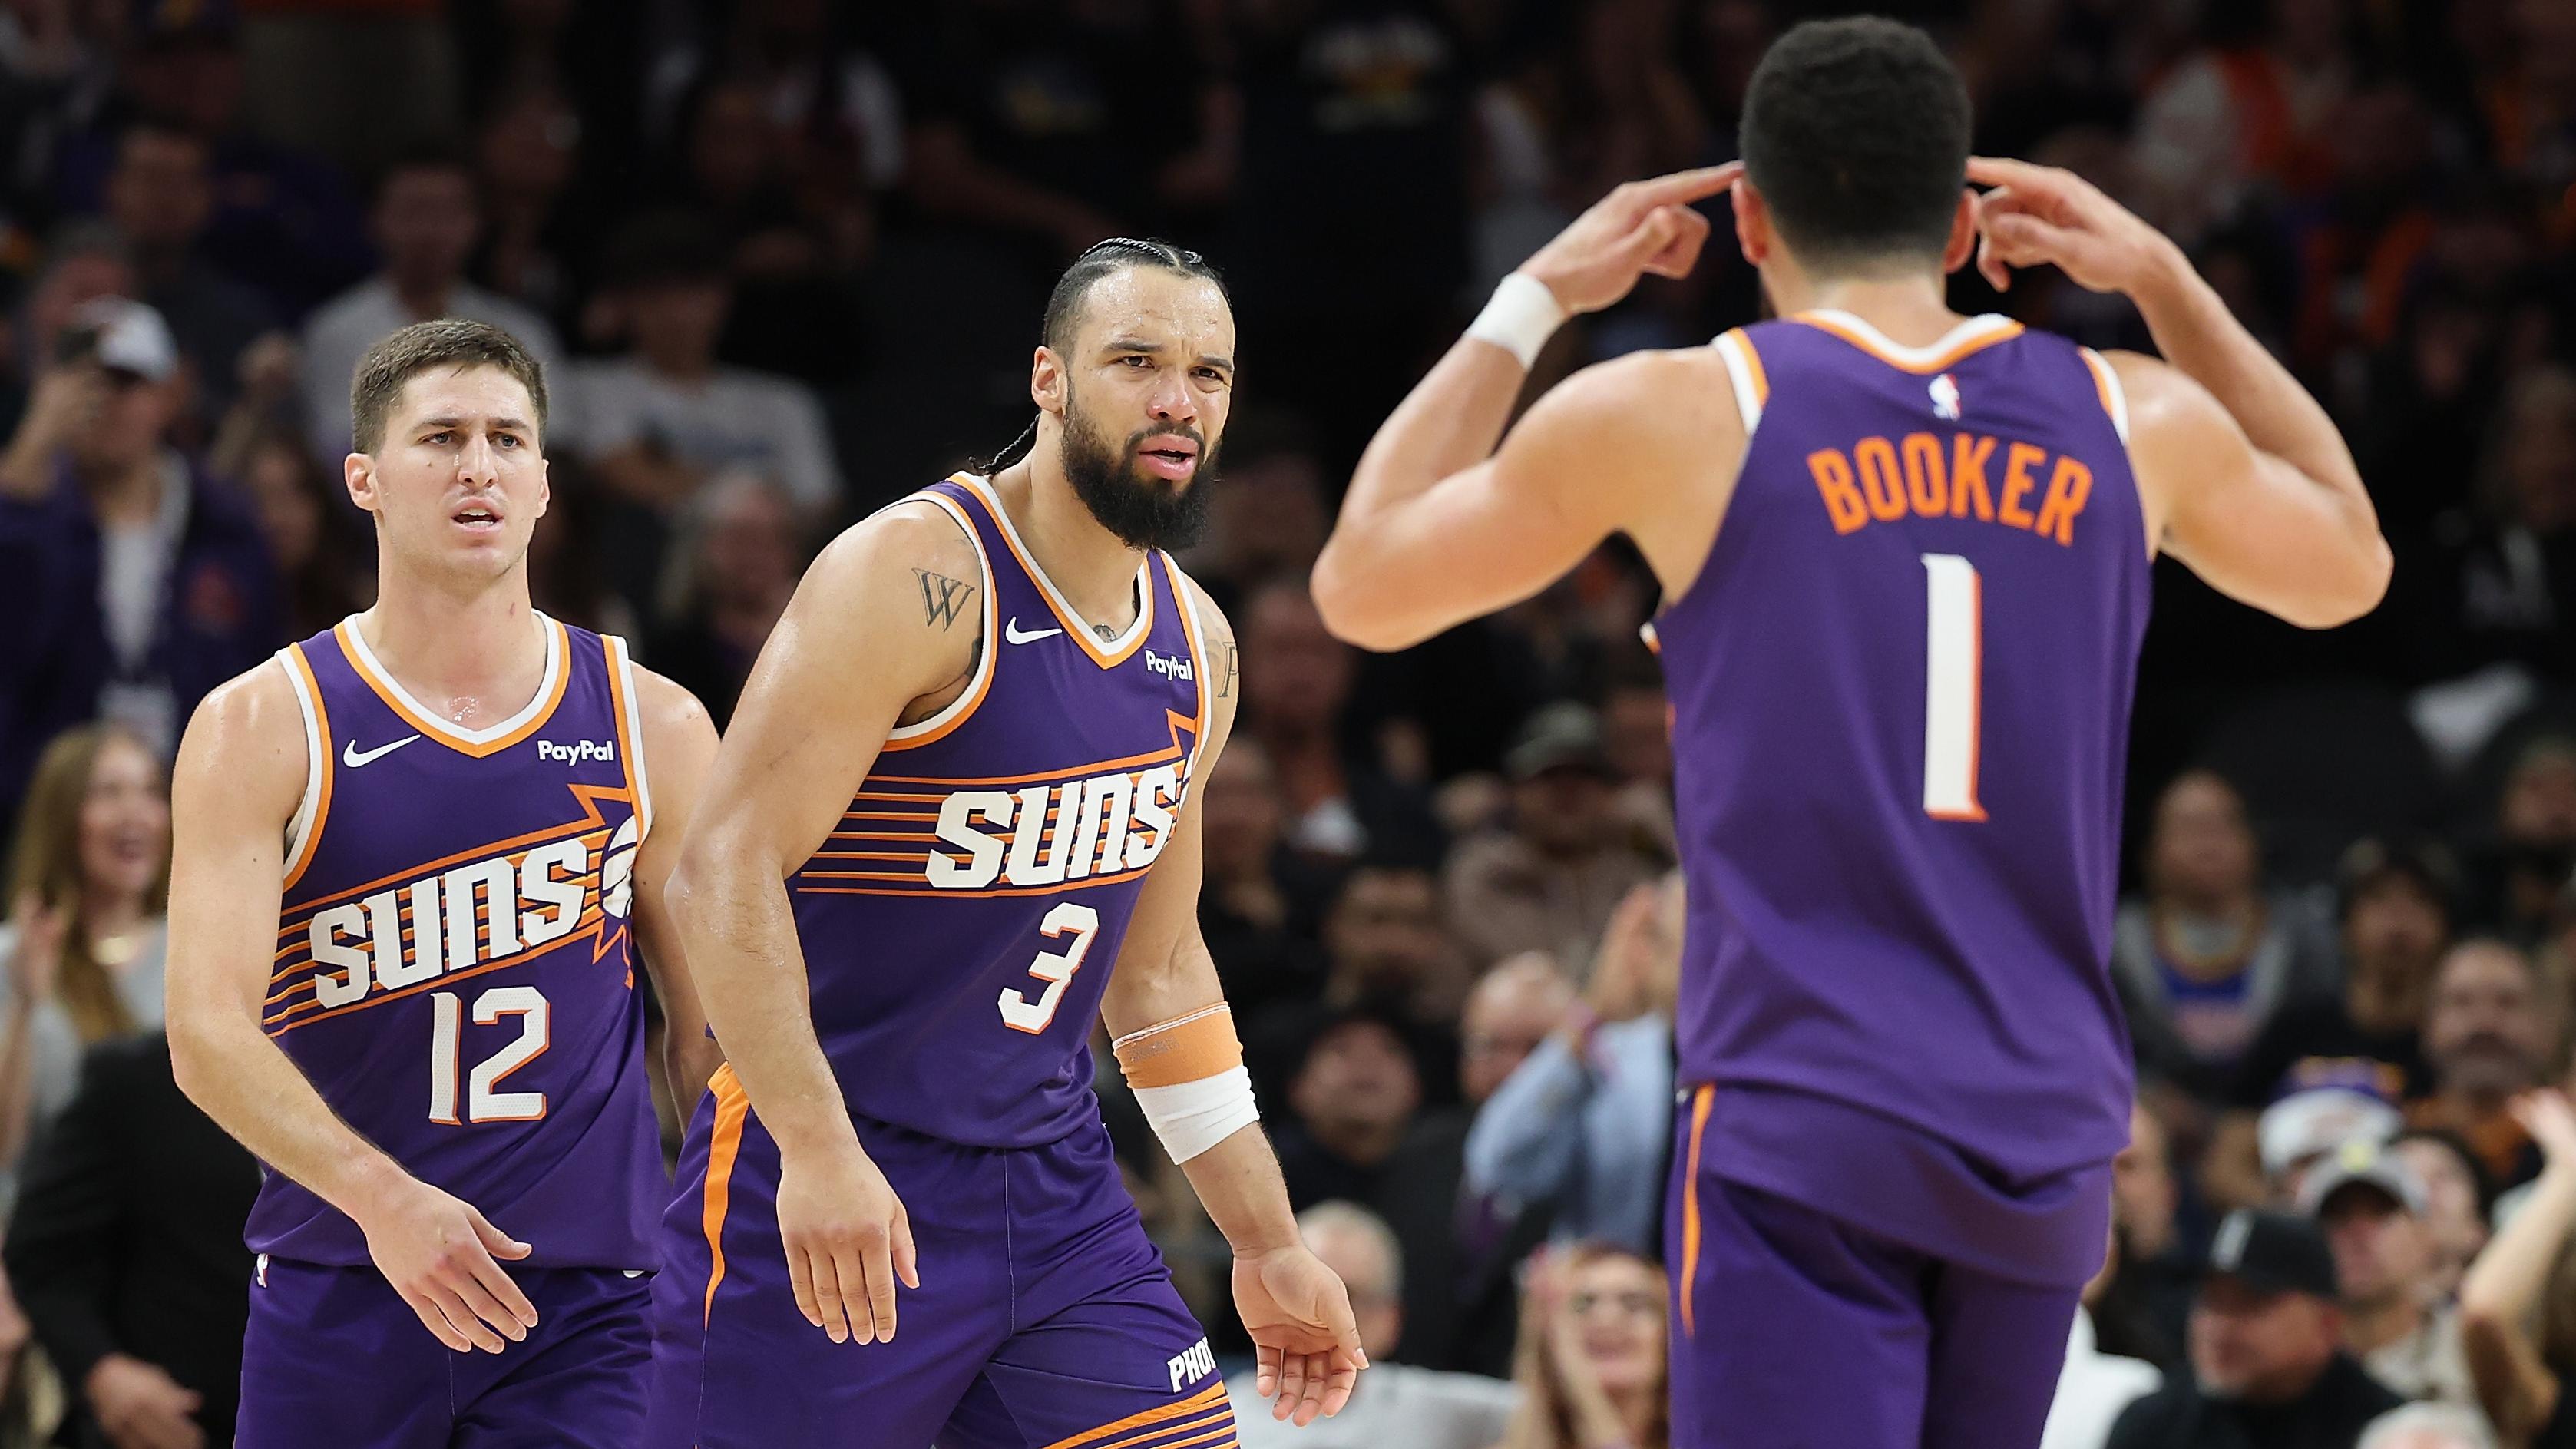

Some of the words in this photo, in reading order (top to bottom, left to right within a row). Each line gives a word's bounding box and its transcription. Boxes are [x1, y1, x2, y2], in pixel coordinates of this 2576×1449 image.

[1806, 432, 2093, 548] BOOKER
[1145, 650, 1193, 680] PayPal
[1920, 553, 1989, 822] 1
[537, 739, 614, 766] PayPal
[924, 765, 1177, 888] SUNS
[309, 837, 587, 1009] SUNS
[997, 901, 1099, 1035] 3
[429, 986, 551, 1126] 12
